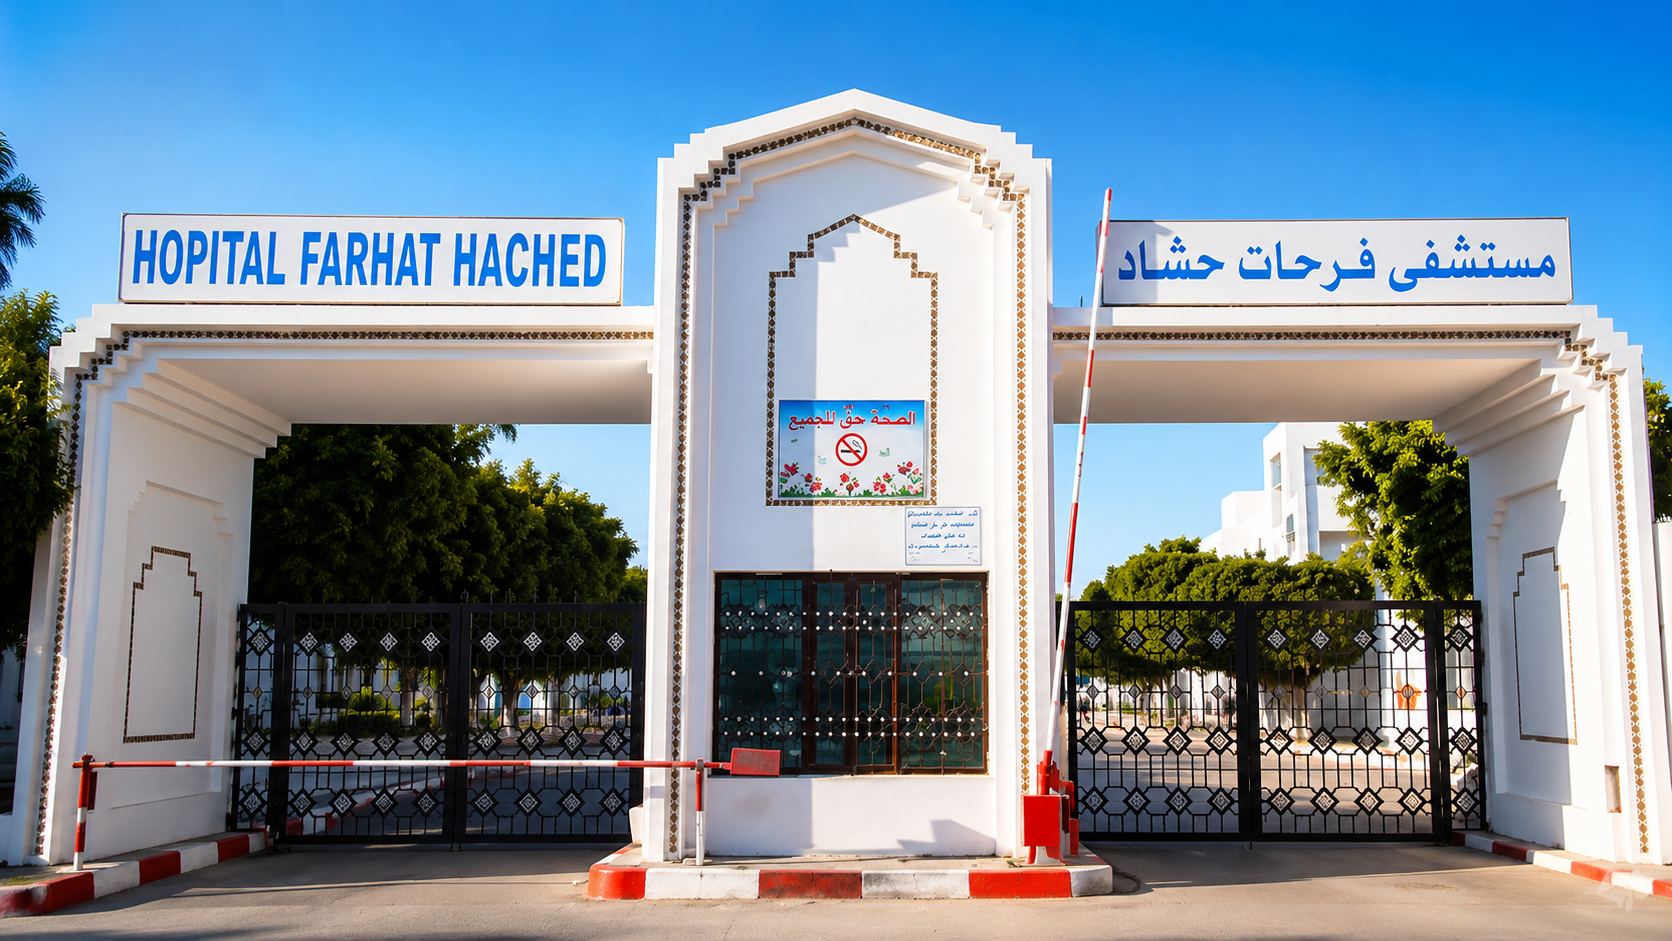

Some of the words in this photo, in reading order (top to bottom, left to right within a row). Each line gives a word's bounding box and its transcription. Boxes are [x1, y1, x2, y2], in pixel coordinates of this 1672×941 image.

[133, 230, 286, 285] HOPITAL
[300, 232, 441, 286] FARHAT
[454, 233, 607, 287] HACHED
[1118, 236, 1225, 280] حشاد
[1239, 238, 1375, 292] فرحات
[1389, 234, 1556, 292] مستشفى
